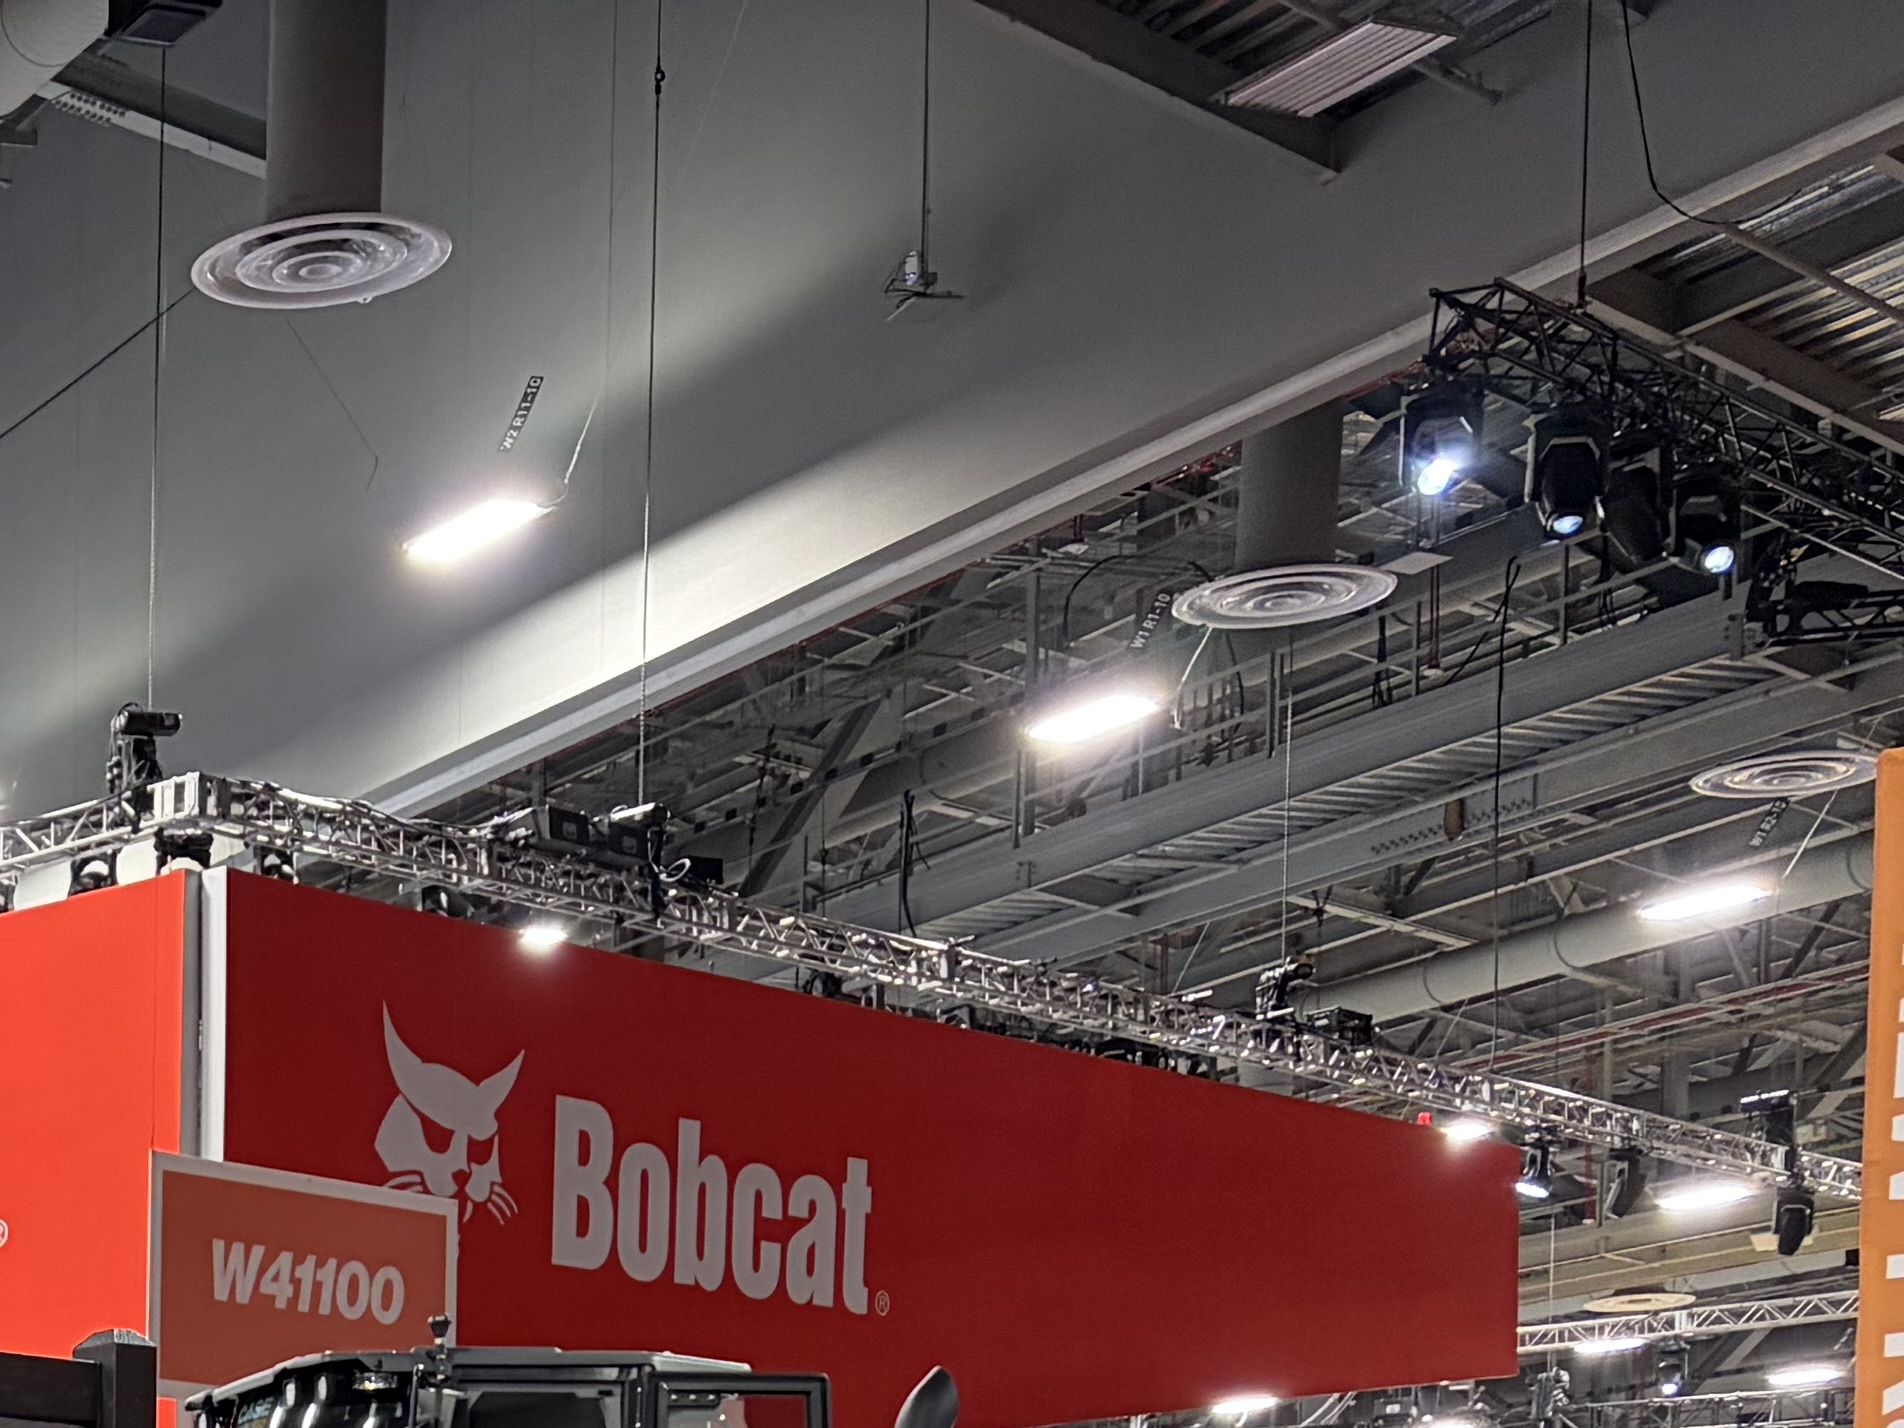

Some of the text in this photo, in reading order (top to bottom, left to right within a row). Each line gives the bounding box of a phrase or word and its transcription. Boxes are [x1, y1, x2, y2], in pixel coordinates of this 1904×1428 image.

[513, 378, 541, 427] R11-10
[1130, 593, 1171, 648] W1 R1-10
[551, 1094, 873, 1316] Bobcat
[211, 1239, 406, 1327] W41100
